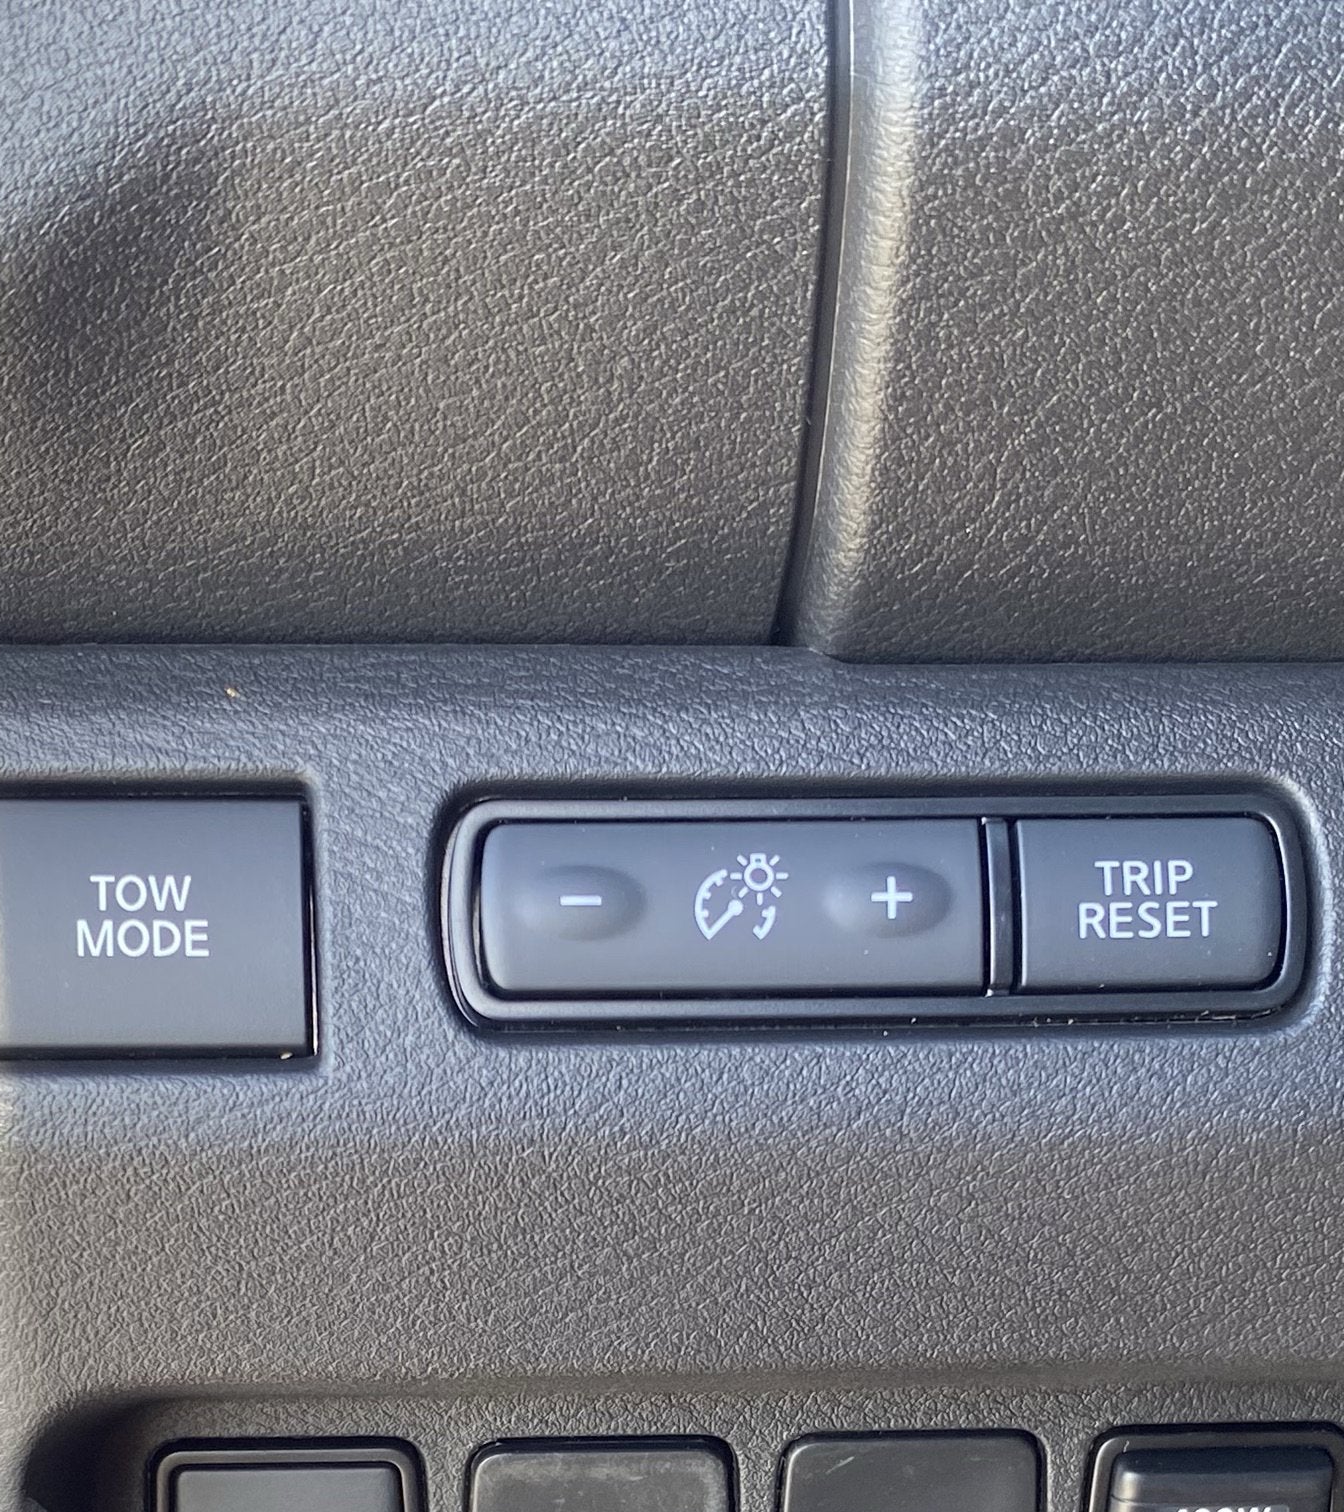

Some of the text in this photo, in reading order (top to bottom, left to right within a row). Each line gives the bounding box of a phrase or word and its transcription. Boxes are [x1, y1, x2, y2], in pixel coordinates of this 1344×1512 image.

[89, 874, 192, 912] TOW
[1094, 859, 1194, 896] TRIP
[76, 918, 210, 958] MODE
[1078, 900, 1219, 939] RESET
